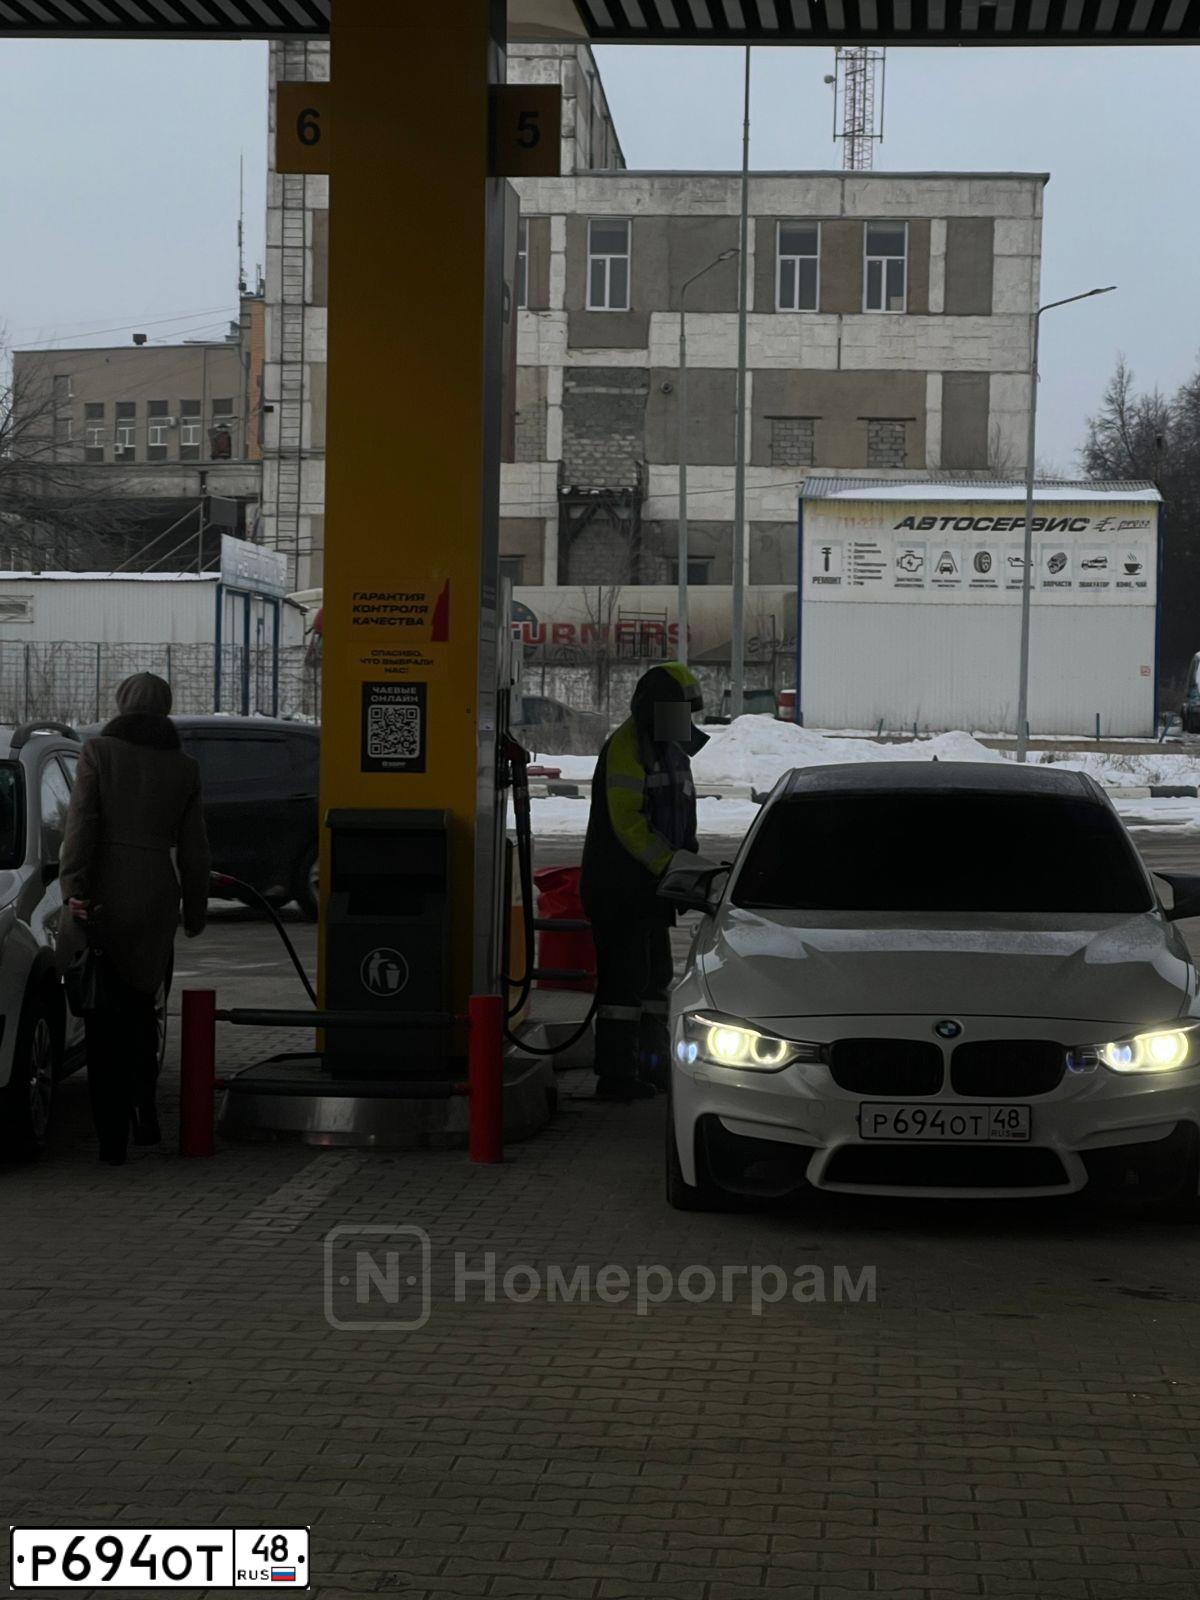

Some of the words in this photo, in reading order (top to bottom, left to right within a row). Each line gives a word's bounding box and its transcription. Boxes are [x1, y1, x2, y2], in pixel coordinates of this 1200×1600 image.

[296, 108, 321, 145] 6
[514, 111, 540, 149] 5
[893, 516, 1090, 532] АВТОСЕРВИС
[352, 592, 425, 601] ГАРАНТИЯ
[352, 605, 429, 613] КОНТРОЛЯ
[352, 617, 424, 625] КАЧЕСТВА
[511, 622, 691, 645] URNERS
[372, 687, 417, 695] ЧАЕВЫЕ
[370, 694, 419, 703] ОНЛАЙН
[873, 1109, 983, 1136] Р694ОТ
[993, 1109, 1020, 1129] 48
